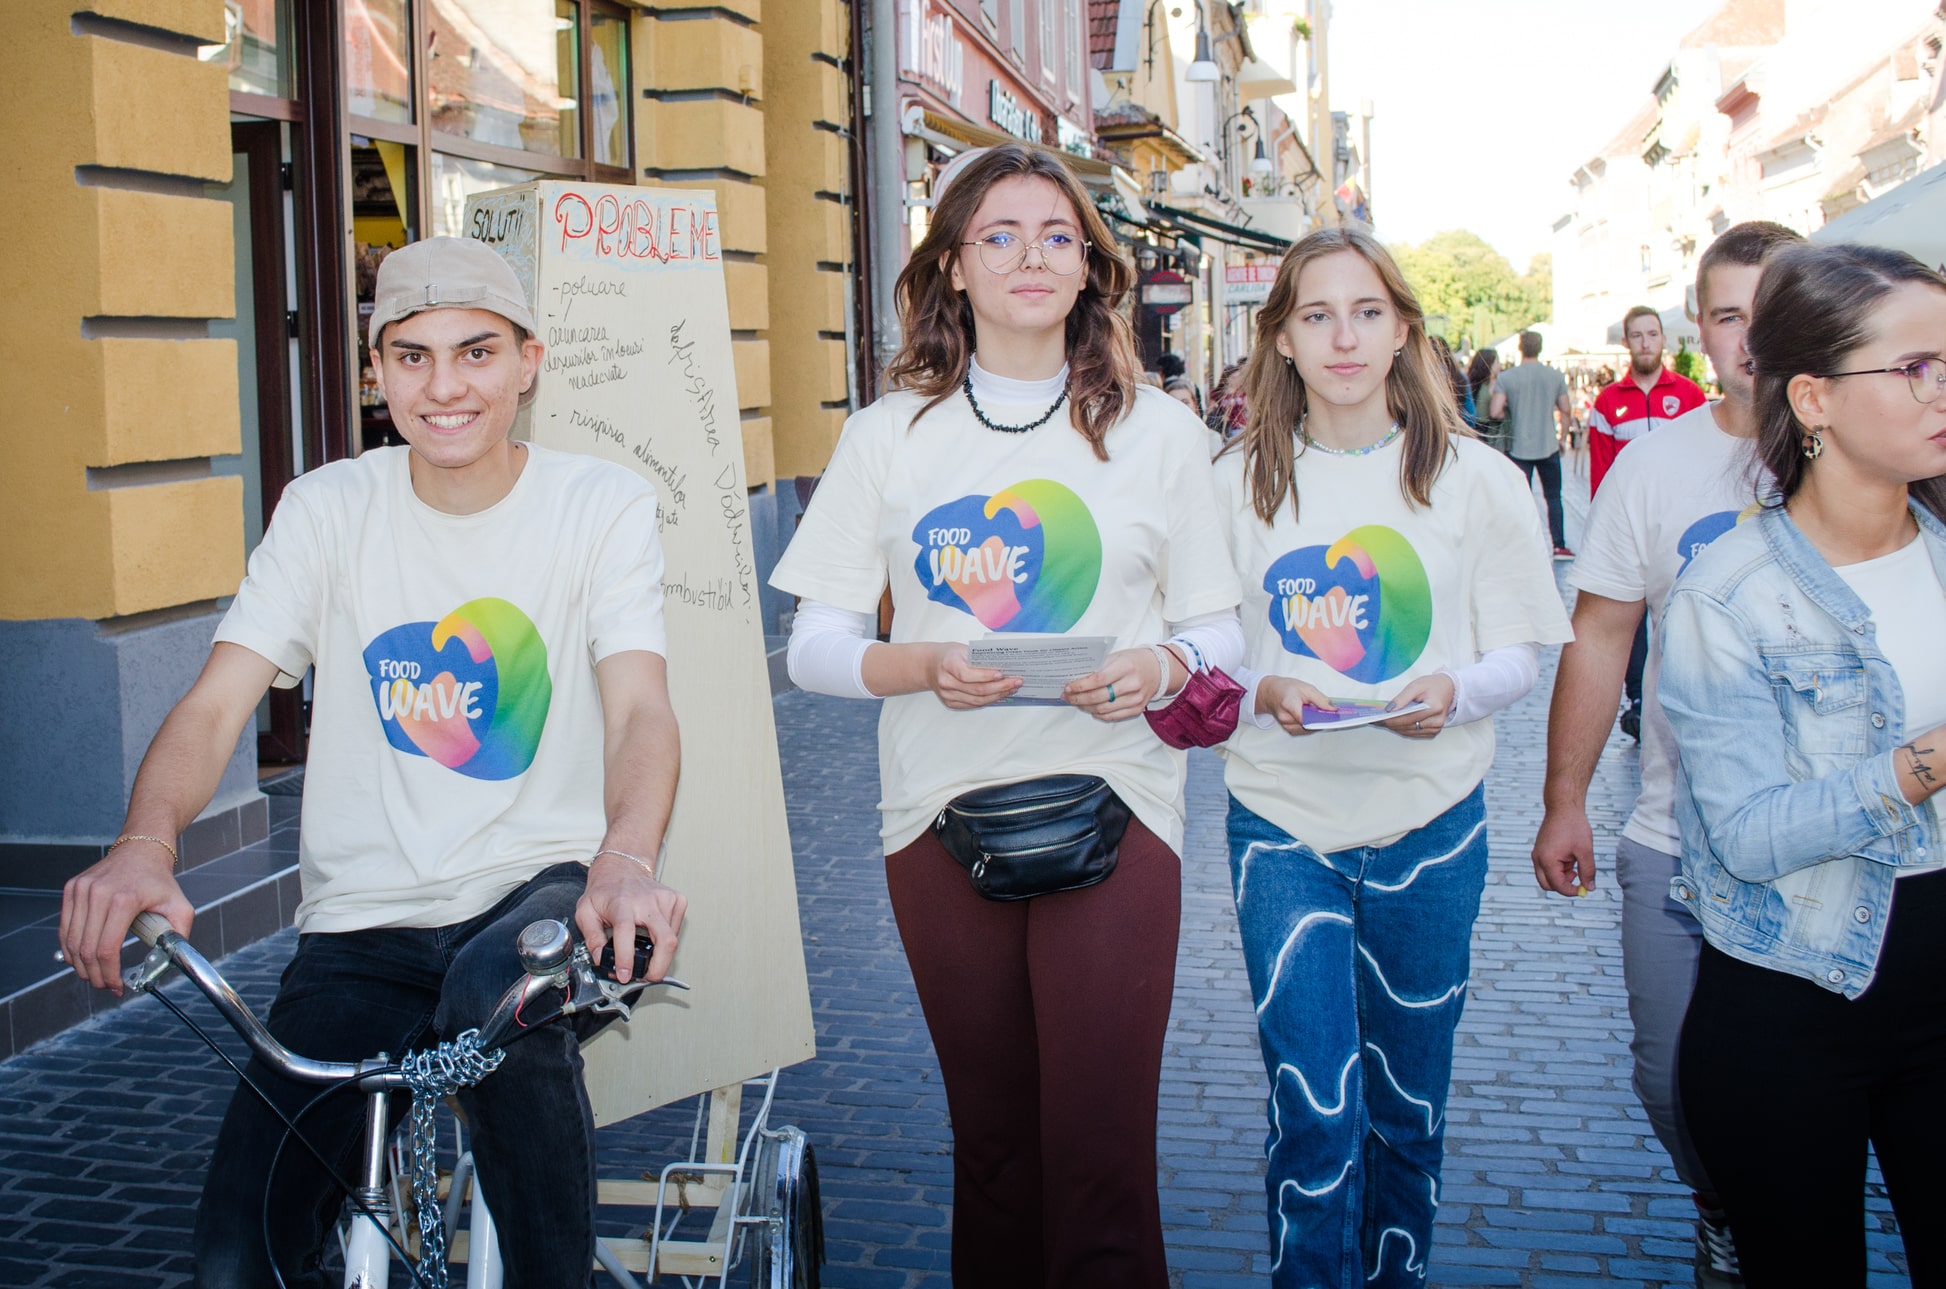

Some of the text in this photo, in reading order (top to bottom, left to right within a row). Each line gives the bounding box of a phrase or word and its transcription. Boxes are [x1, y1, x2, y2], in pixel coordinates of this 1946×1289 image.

[555, 192, 719, 264] PROBLEME
[928, 527, 971, 546] FOOD
[1690, 542, 1712, 558] FO
[929, 545, 1030, 586] WAVE
[1277, 578, 1316, 595] FOOD
[1281, 594, 1369, 632] WAVE
[379, 658, 421, 680] FOOD
[379, 680, 483, 722] WAVE
